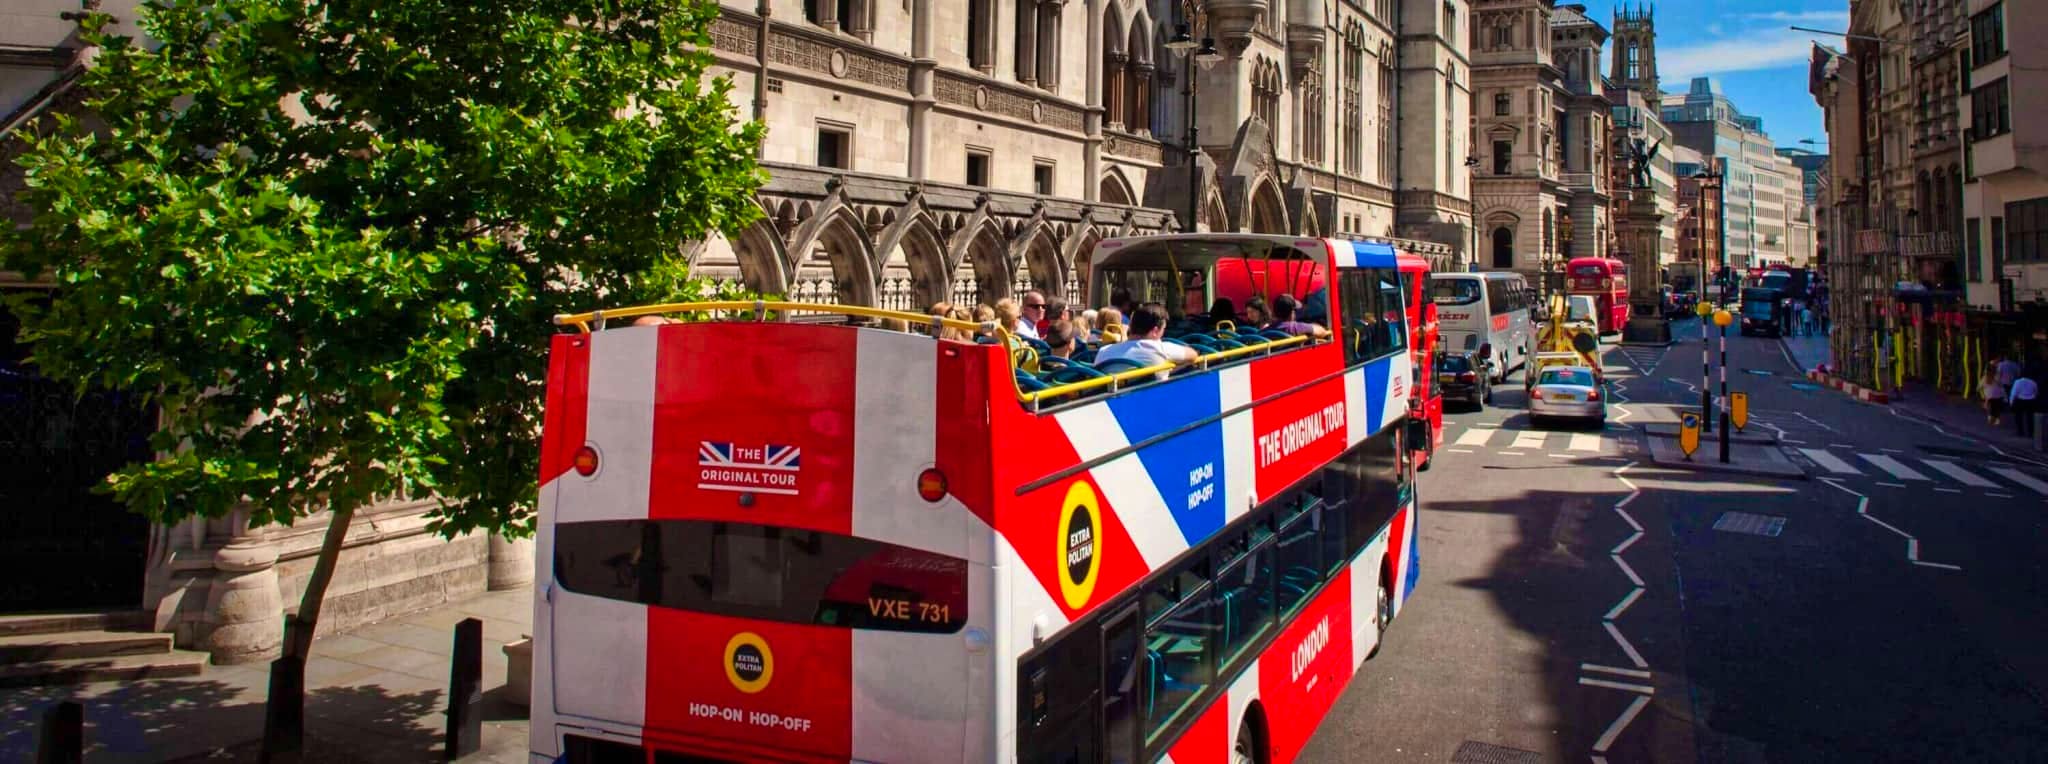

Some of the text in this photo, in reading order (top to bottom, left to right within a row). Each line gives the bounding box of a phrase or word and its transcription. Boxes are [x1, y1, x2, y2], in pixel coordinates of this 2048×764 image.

[1259, 401, 1345, 469] THE ORIGINAL TOUR
[736, 447, 761, 460] THE
[701, 469, 796, 486] ORIGINAL TOUR
[1190, 462, 1214, 487] HOP-ON
[1188, 483, 1214, 510] HOP-OFF
[1070, 527, 1091, 548] EXTRA
[1068, 542, 1093, 566] POLITAN
[868, 597, 949, 624] VXE 731
[737, 654, 760, 663] EXTRA
[1291, 613, 1329, 684] LONDON
[735, 662, 762, 673] POLITAN
[689, 701, 812, 732] HOP-ON HOP-OFF
